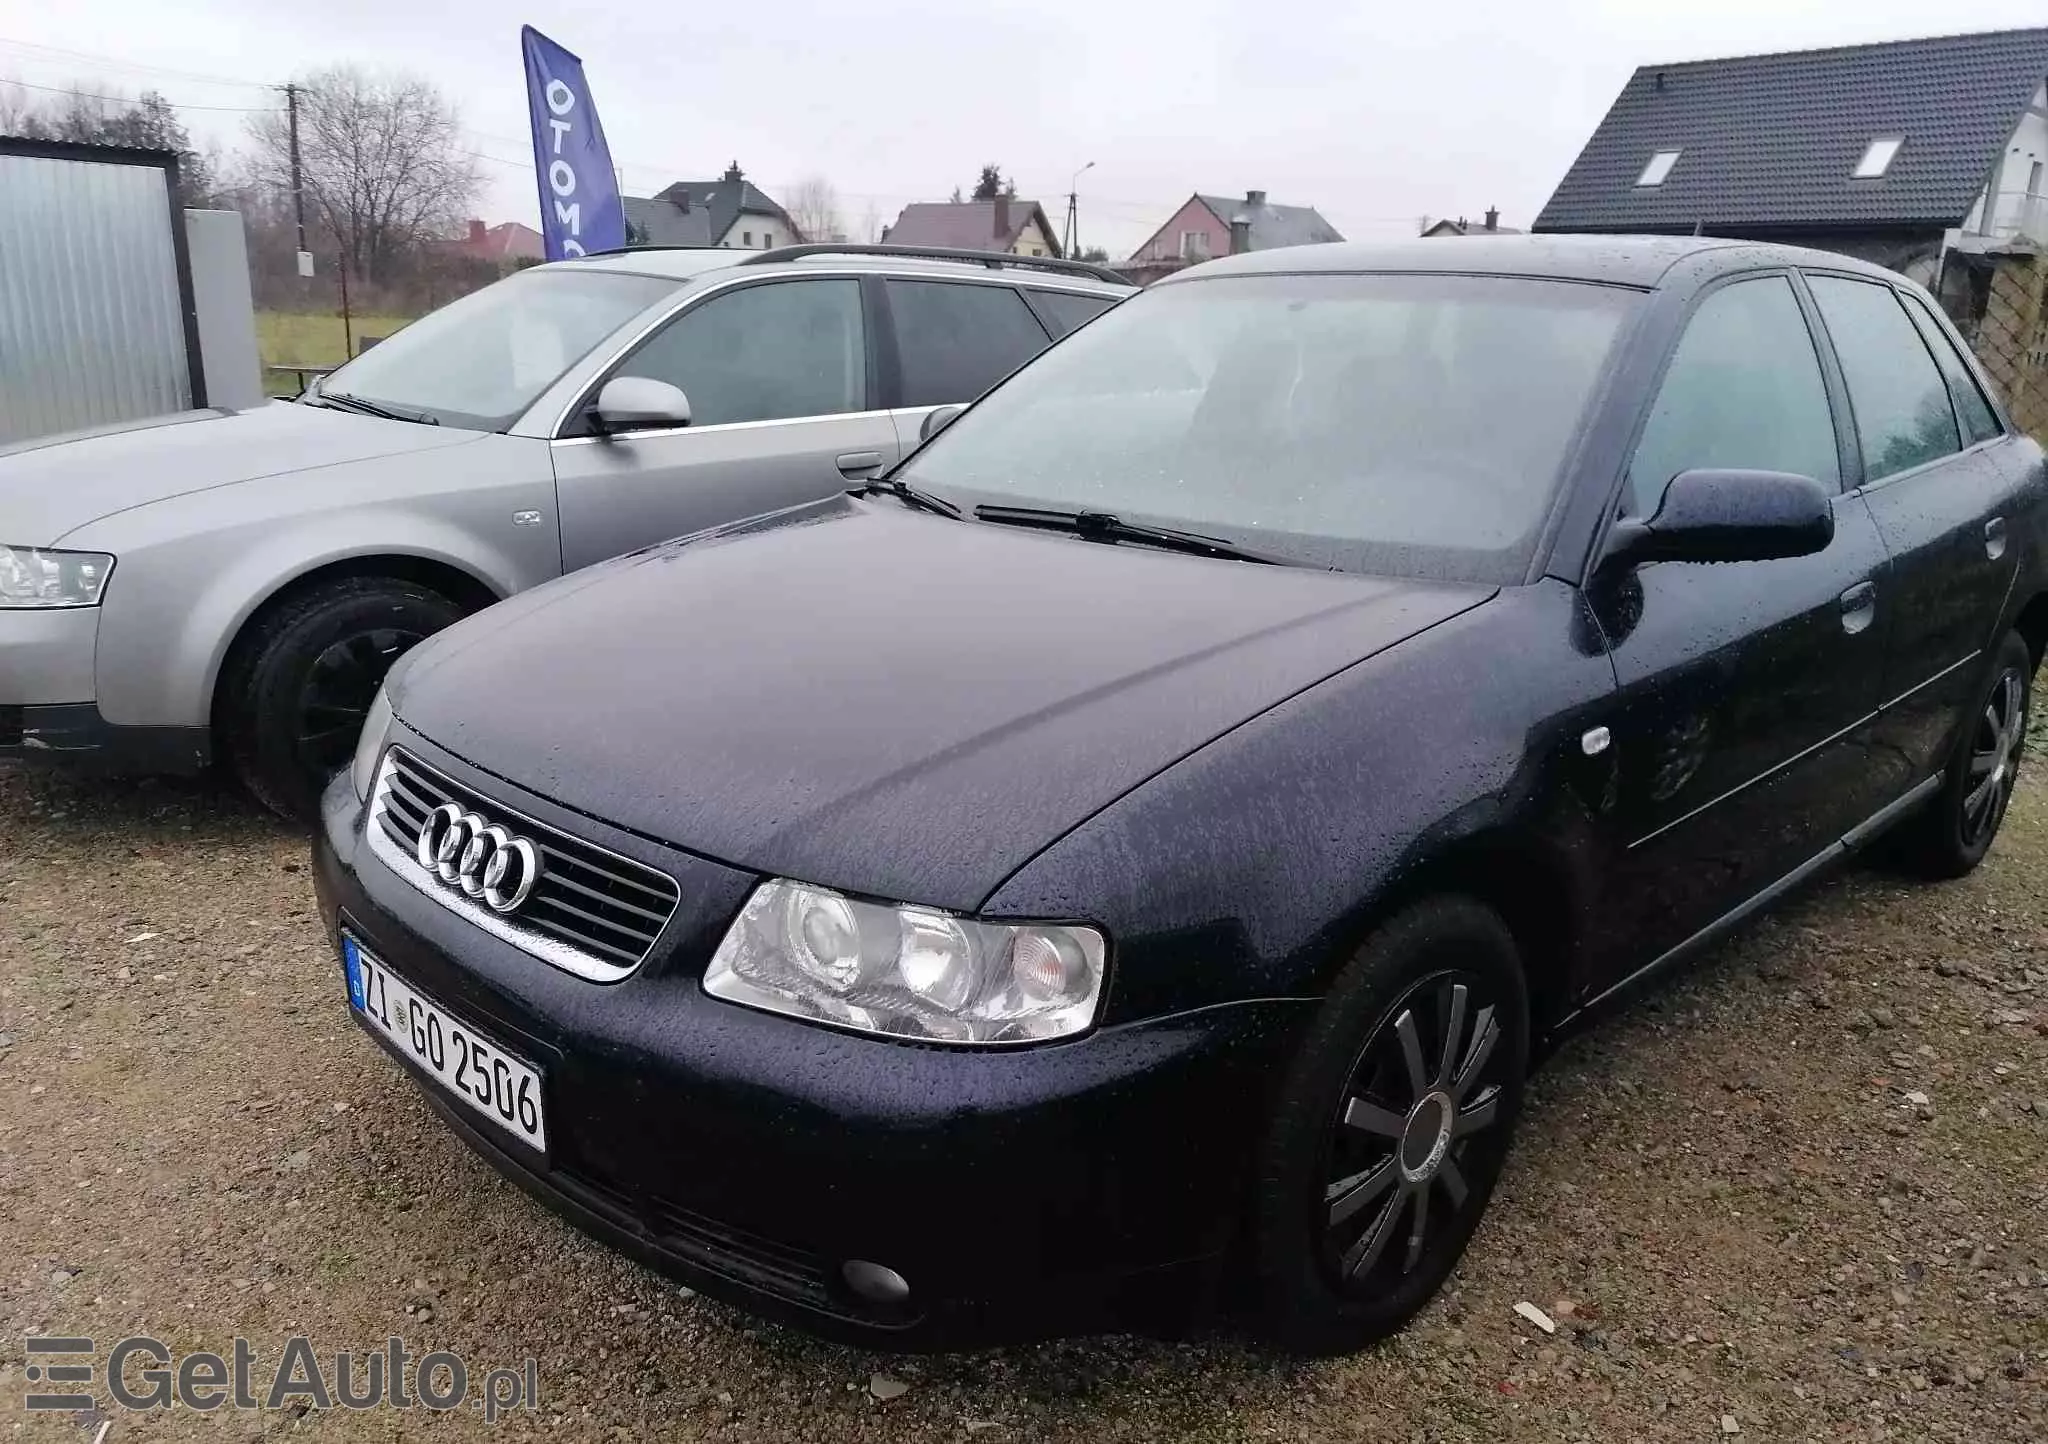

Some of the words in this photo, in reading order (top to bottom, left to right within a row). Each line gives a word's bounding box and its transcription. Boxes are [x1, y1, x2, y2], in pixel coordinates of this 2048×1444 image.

[361, 957, 392, 1030] ZI
[409, 998, 444, 1072] GO
[453, 1030, 537, 1135] 2506
